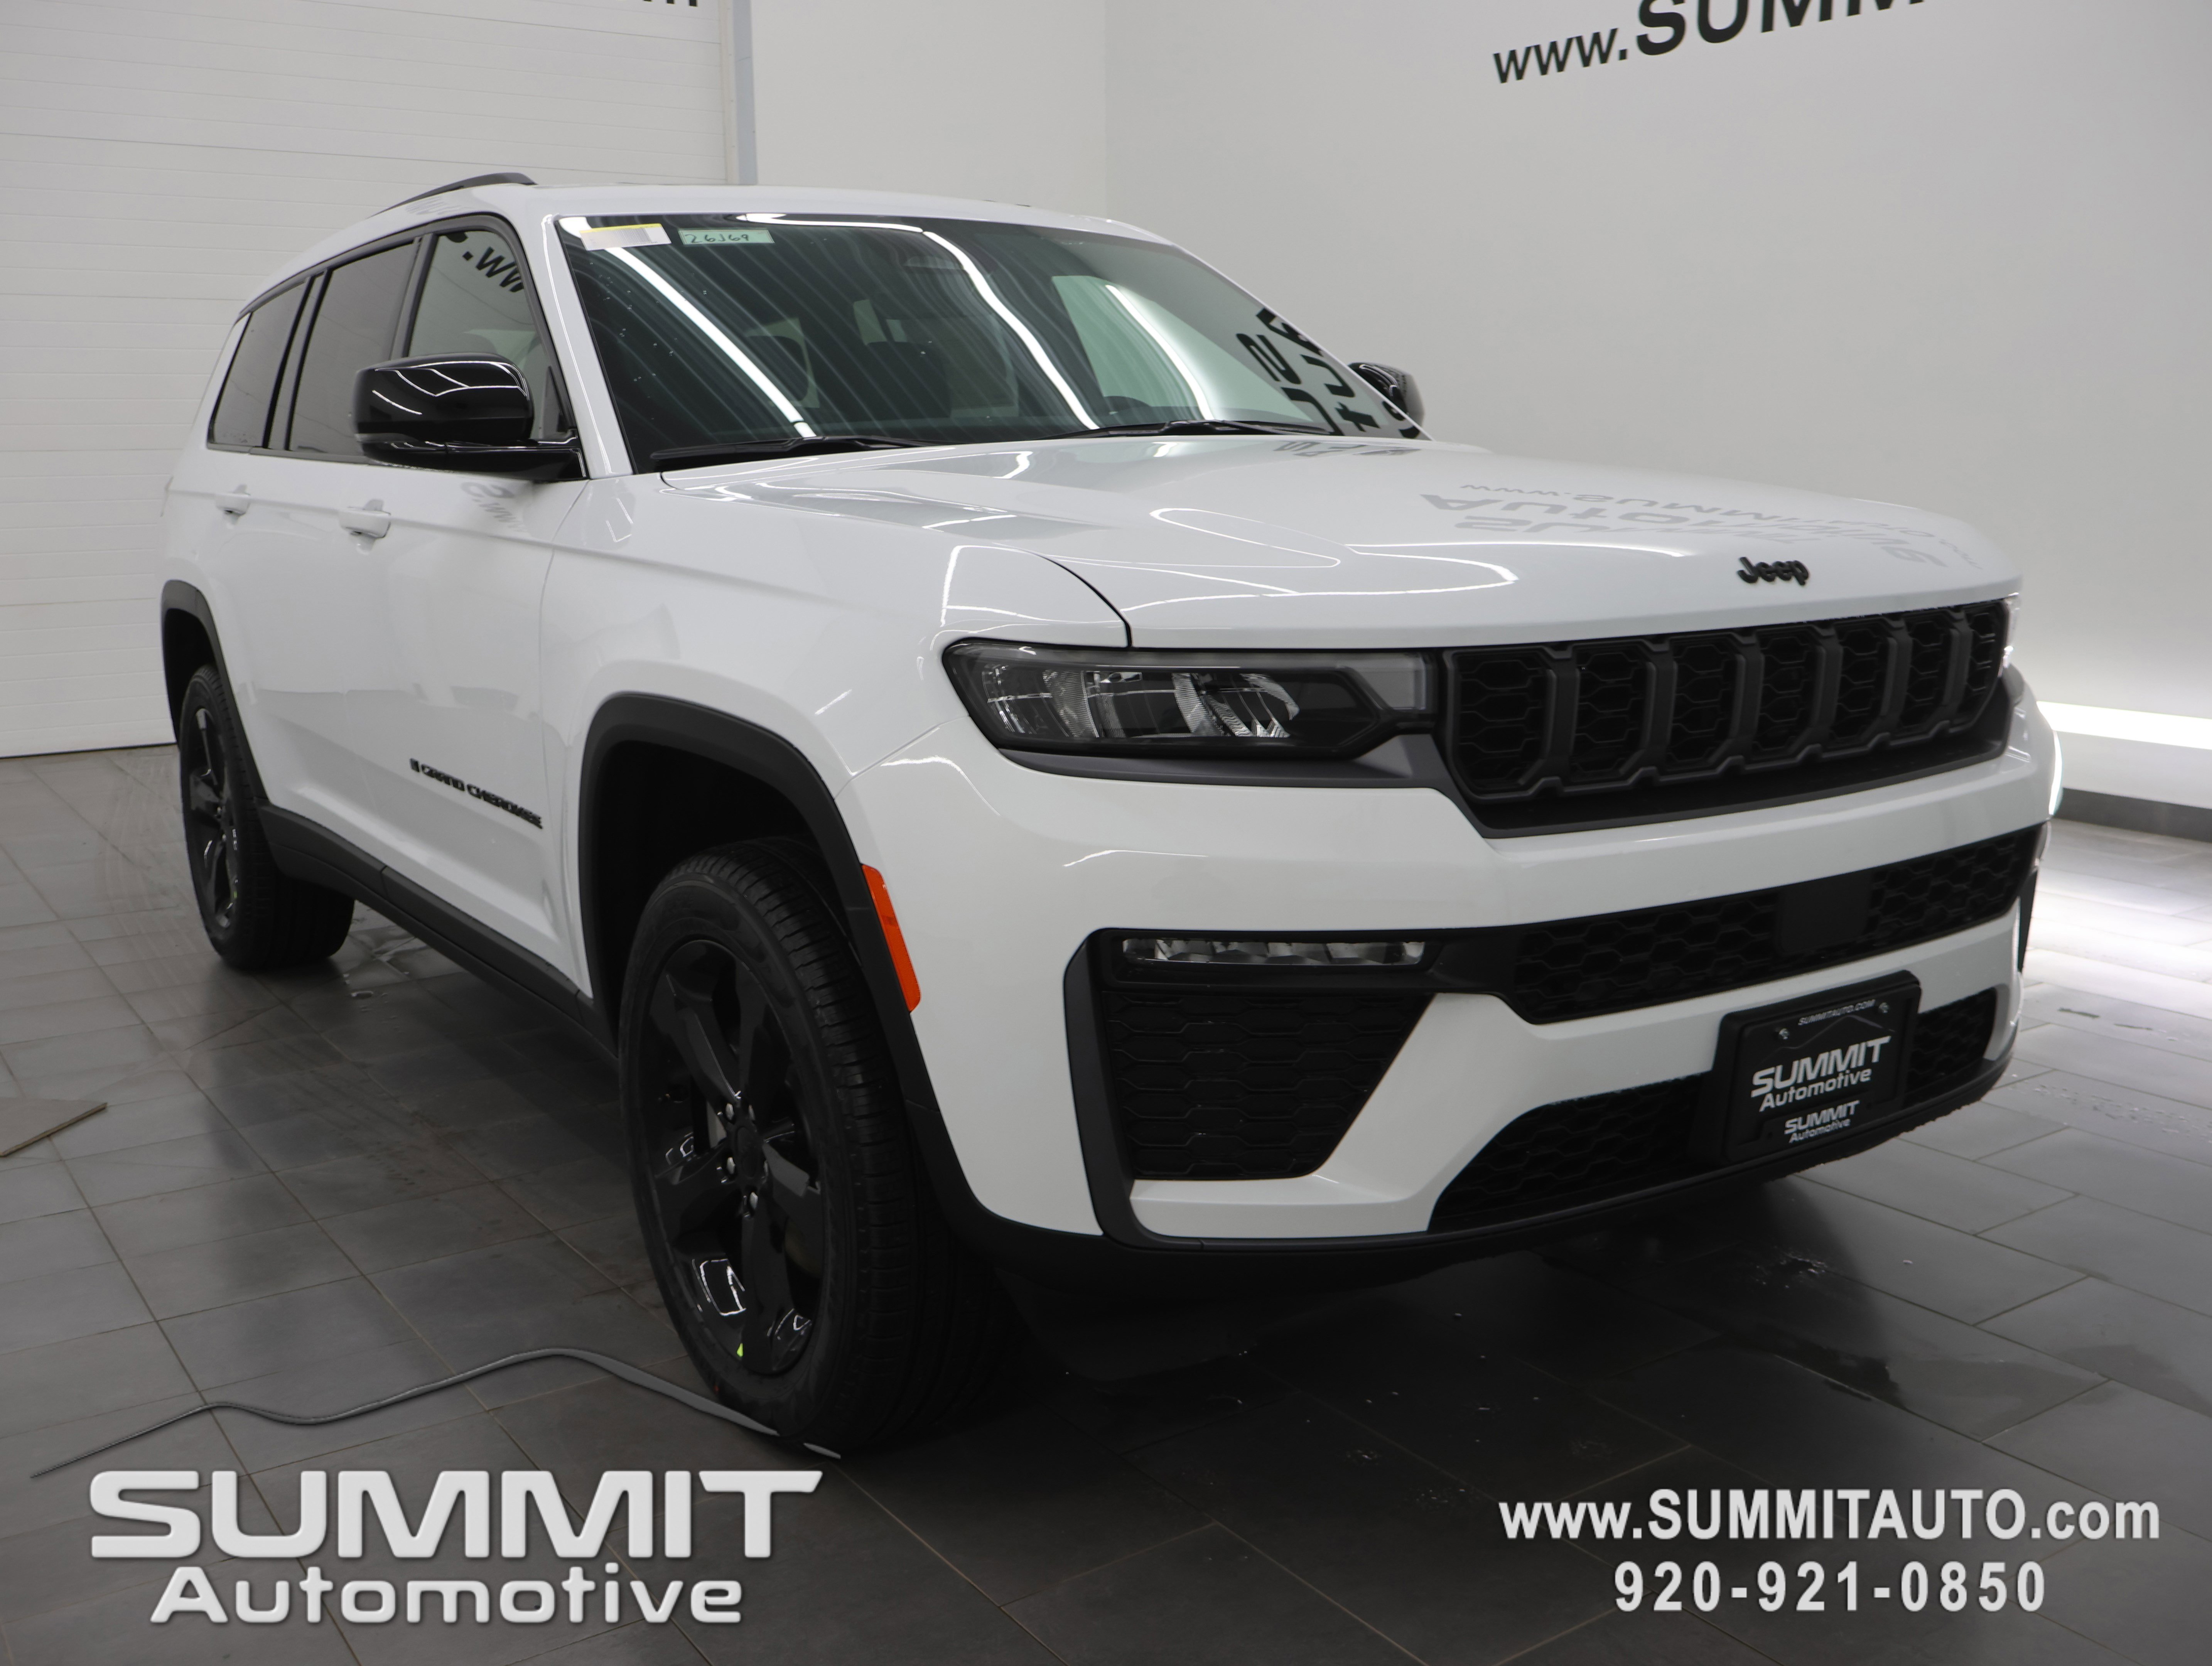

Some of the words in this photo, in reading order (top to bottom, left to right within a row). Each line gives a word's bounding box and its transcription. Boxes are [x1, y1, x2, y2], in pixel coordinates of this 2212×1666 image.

[1737, 556, 1809, 586] Jeep
[1751, 1035, 1891, 1098] SUMMIT
[1759, 1068, 1872, 1112] Automotive
[1784, 1100, 1860, 1135] SUMMIT
[1788, 1118, 1851, 1143] Automotive
